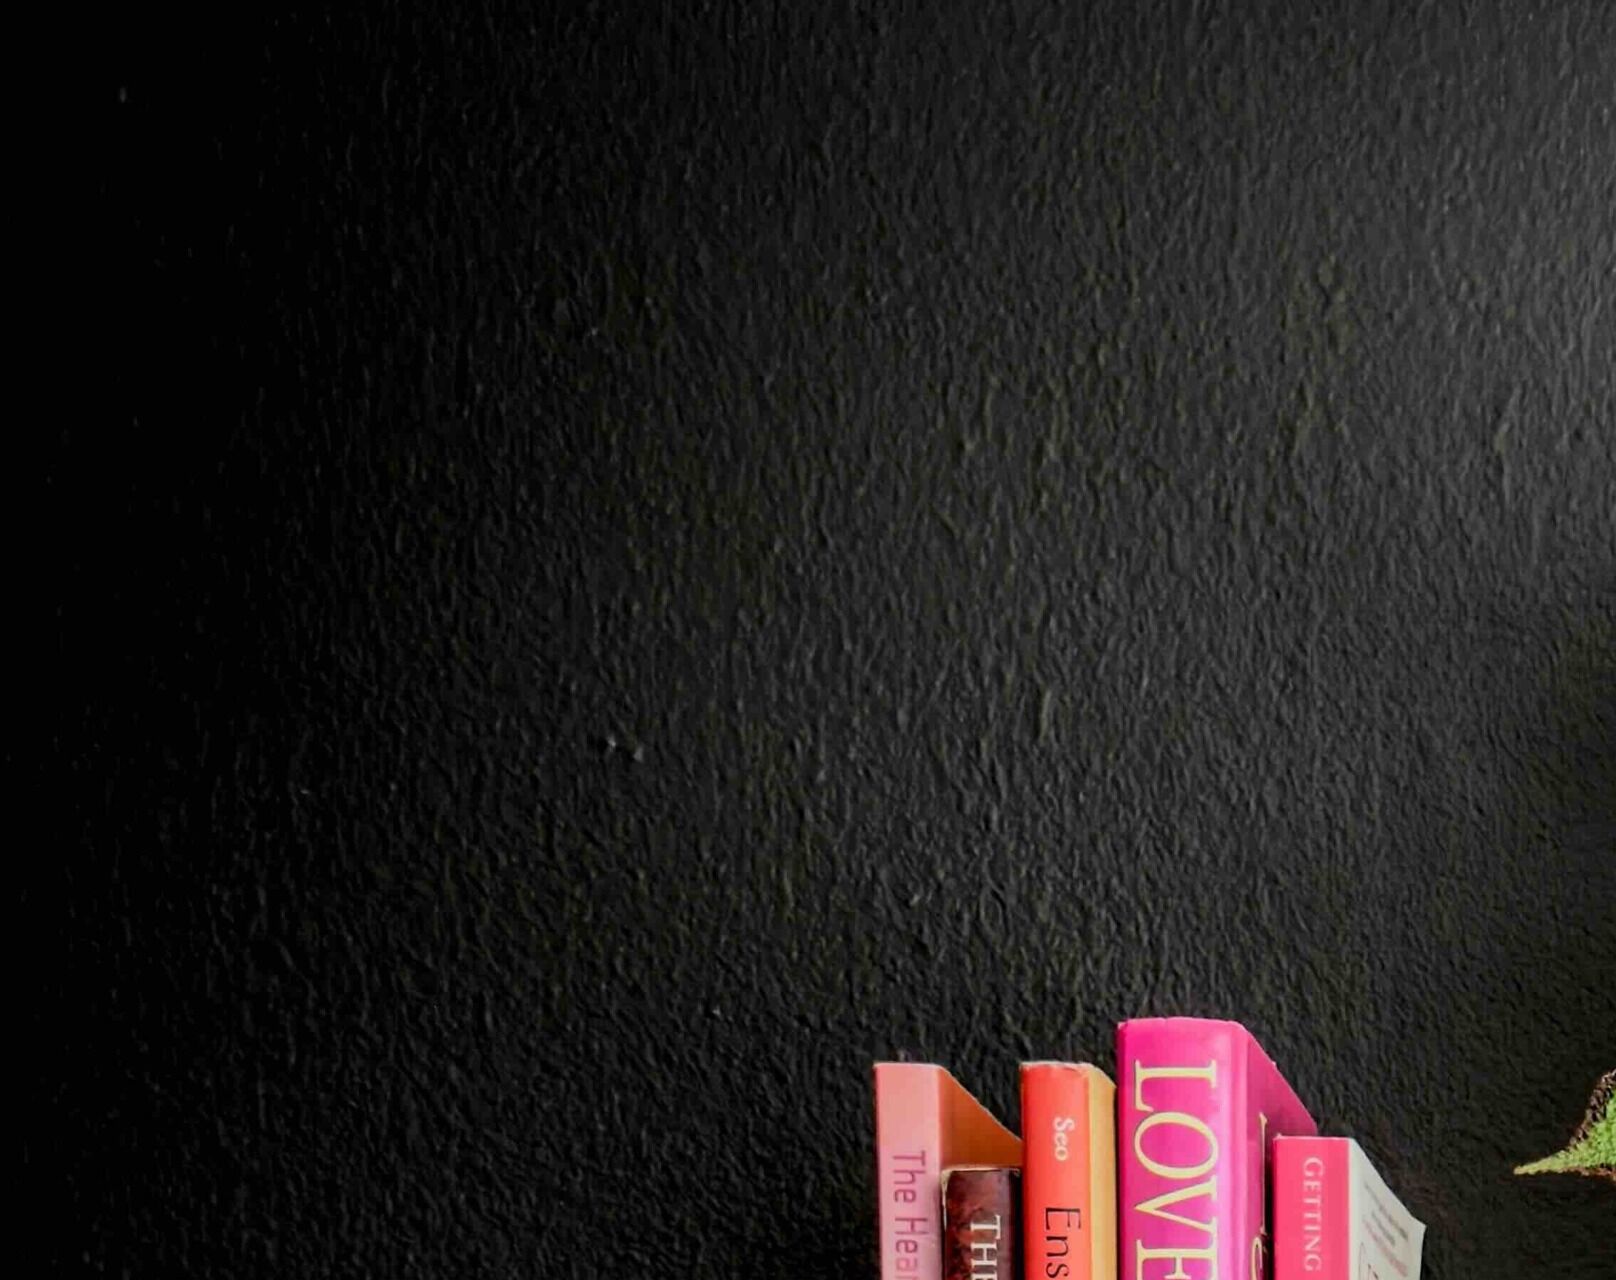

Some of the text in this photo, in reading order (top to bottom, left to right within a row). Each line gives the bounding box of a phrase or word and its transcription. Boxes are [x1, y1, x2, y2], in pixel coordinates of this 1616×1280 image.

[1053, 1116, 1075, 1162] Seo
[892, 1150, 926, 1203] The
[1303, 1157, 1324, 1271] GETTING
